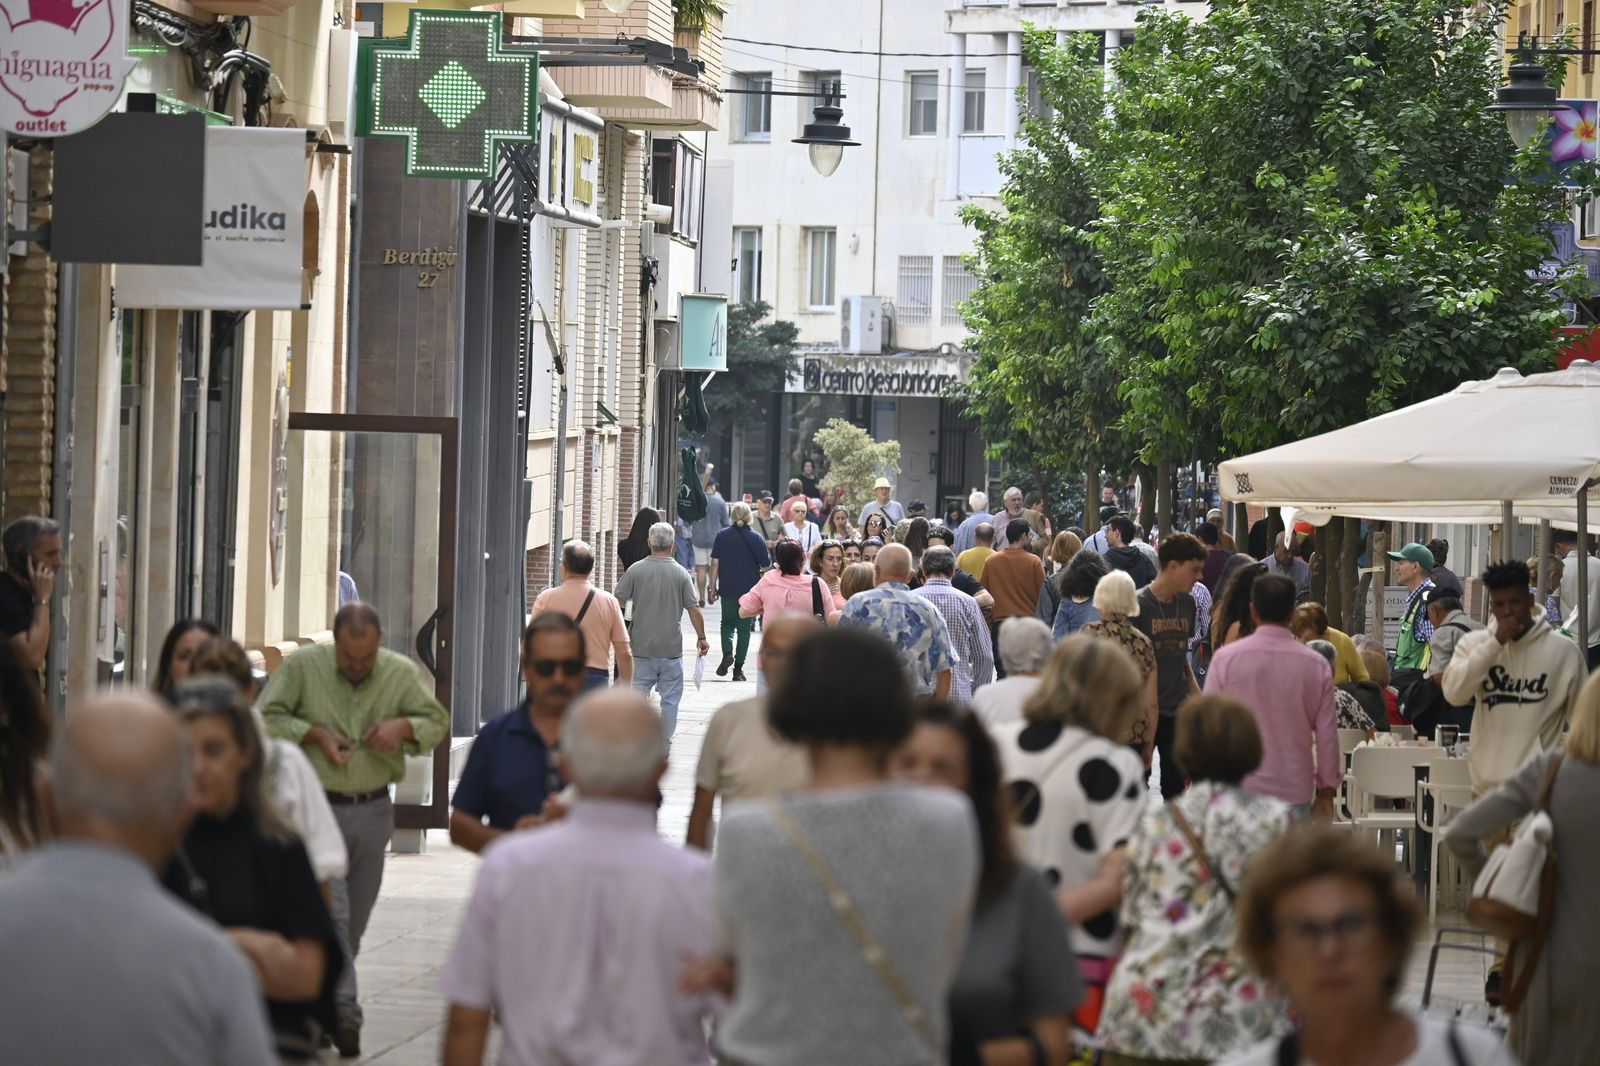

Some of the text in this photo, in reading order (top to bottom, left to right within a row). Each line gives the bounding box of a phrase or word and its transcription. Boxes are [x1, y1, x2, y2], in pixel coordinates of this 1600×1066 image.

[83, 83, 115, 91] pop-up
[15, 118, 67, 132] outlet
[418, 272, 440, 288] 27
[822, 368, 865, 393] centro
